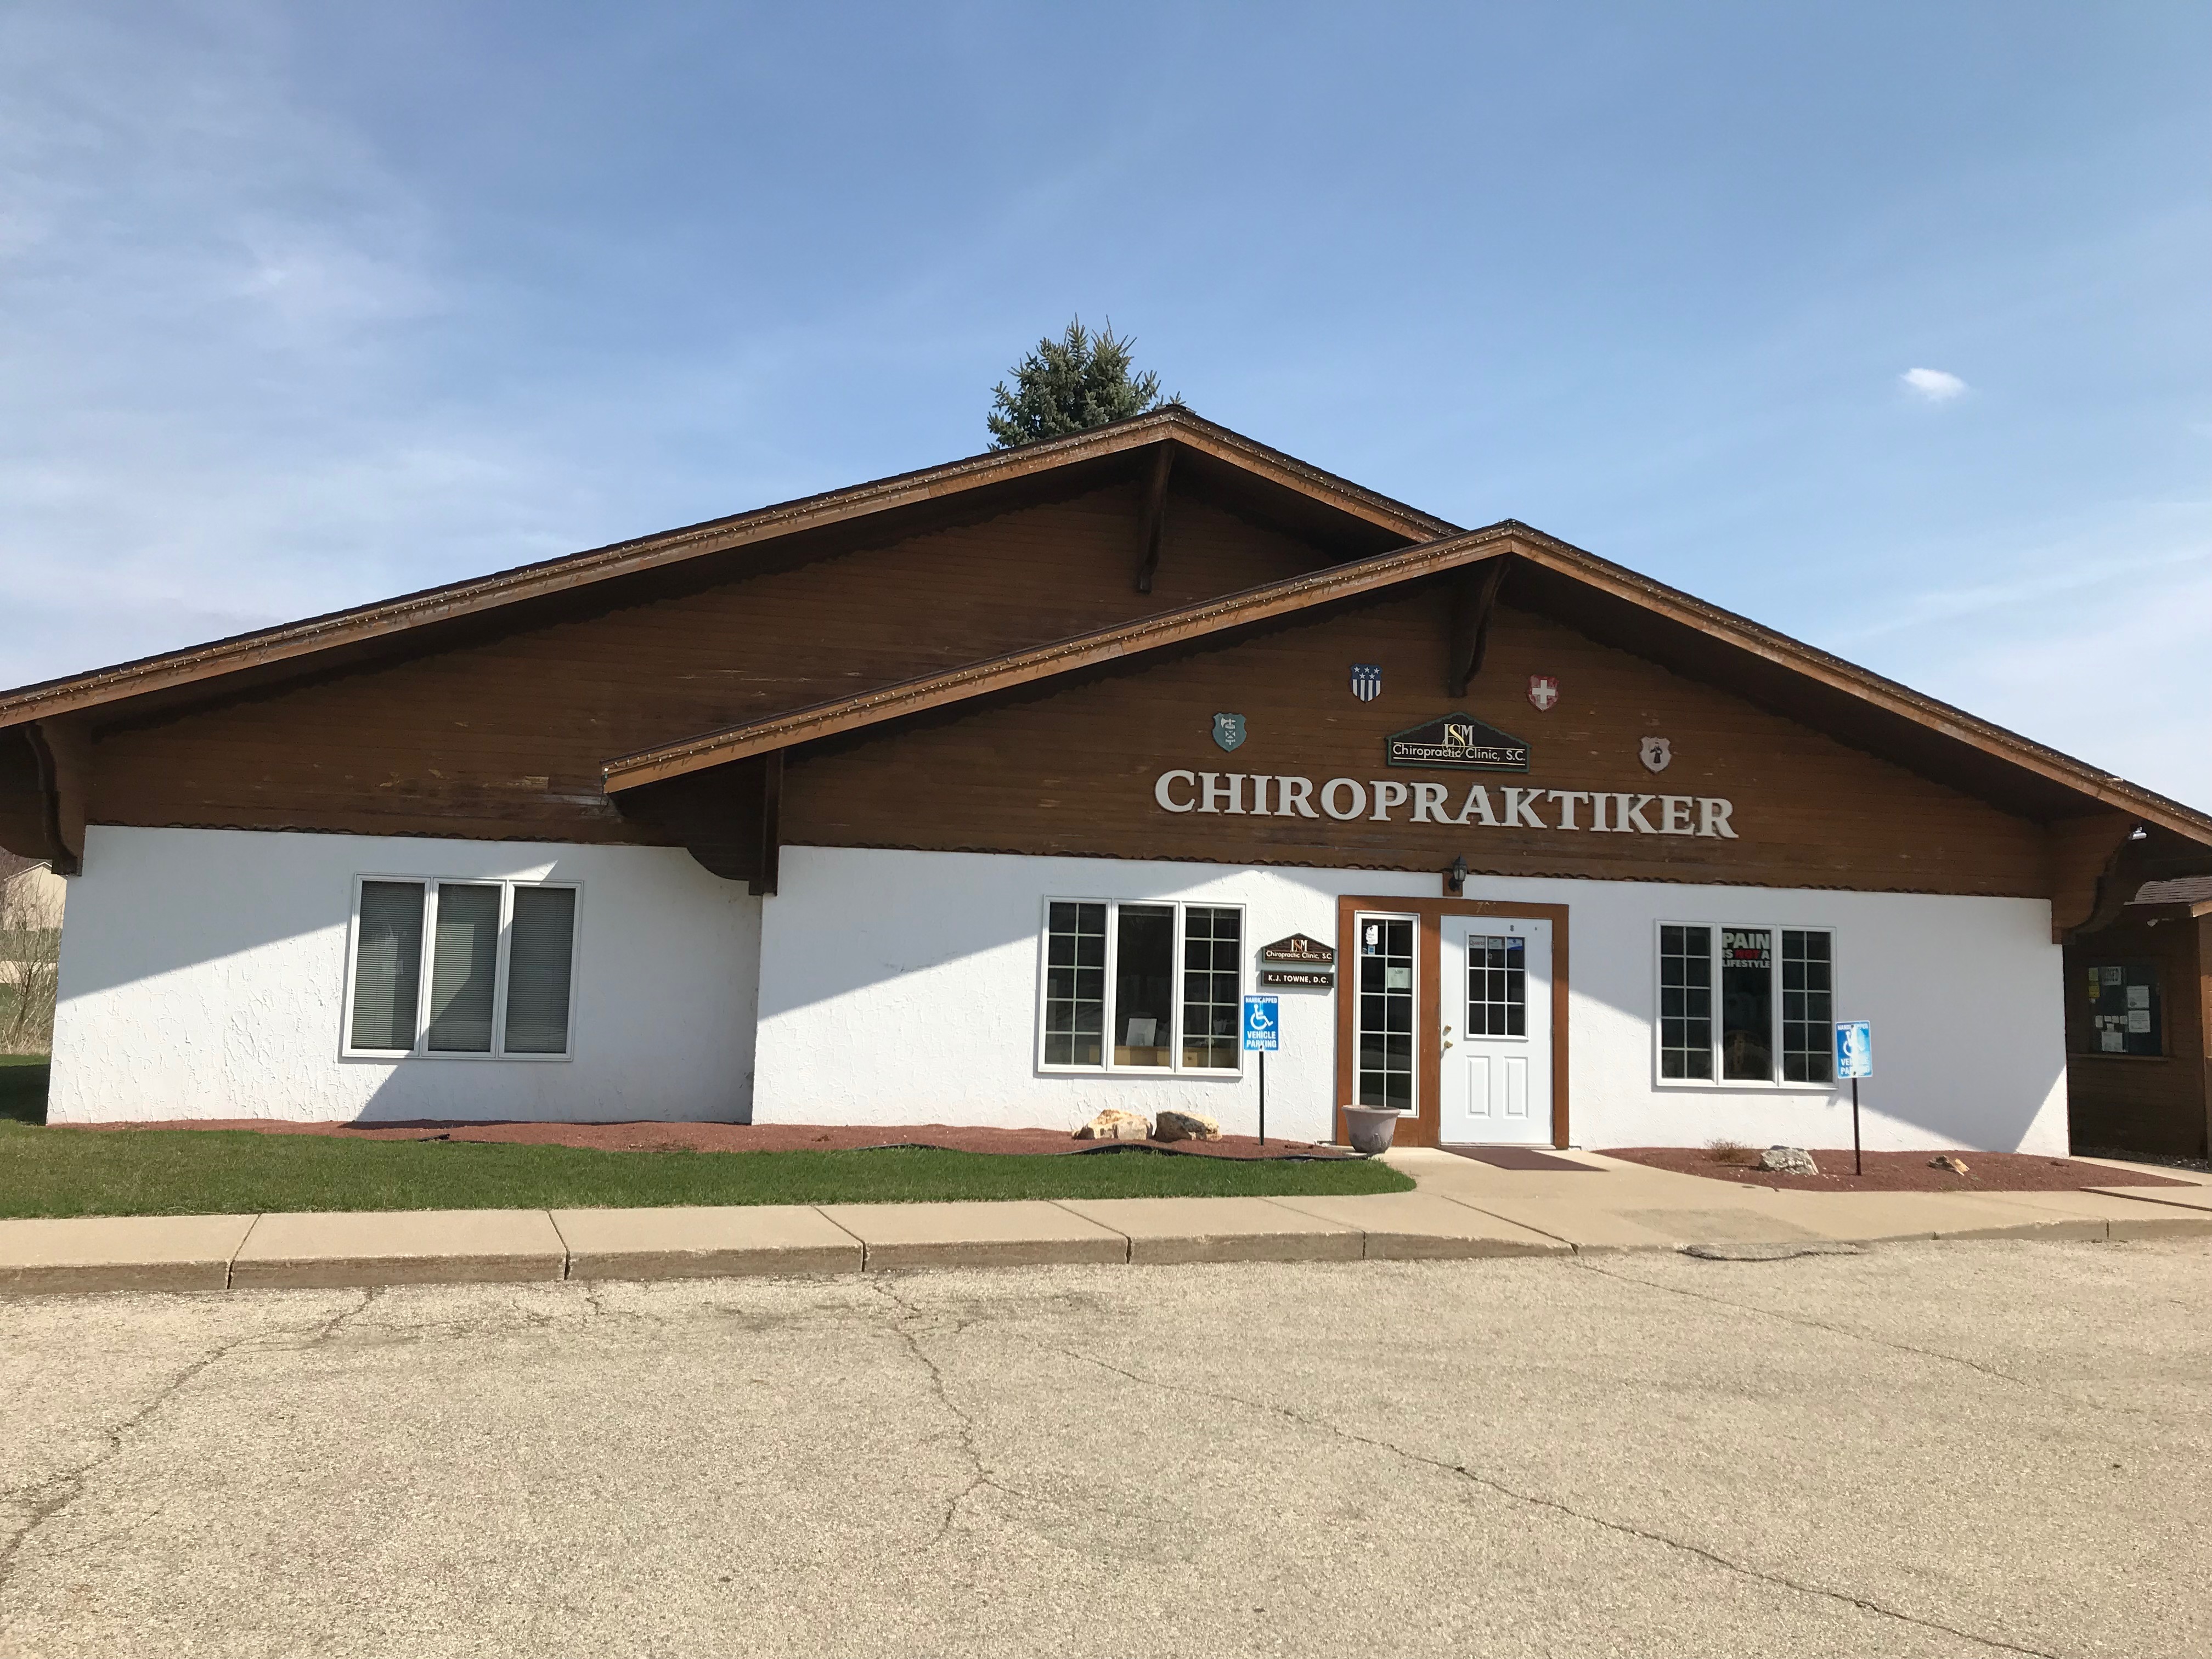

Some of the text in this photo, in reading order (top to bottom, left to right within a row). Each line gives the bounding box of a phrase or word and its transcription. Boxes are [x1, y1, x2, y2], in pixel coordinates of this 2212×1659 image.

[1392, 744, 1526, 761] Chiropractic Clinic, S.C.
[1154, 769, 1740, 839] CHIROPRAKTIKER
[1722, 933, 1770, 949] PAIN
[1266, 950, 1300, 959] Chiropractic
[1722, 949, 1734, 959] IS
[1760, 950, 1770, 960] A
[1722, 960, 1770, 968] LIFESTYLE
[1283, 975, 1311, 984] TOWNE,
[1246, 1031, 1276, 1039] VEHICLE
[1246, 1039, 1277, 1048] PARKING
